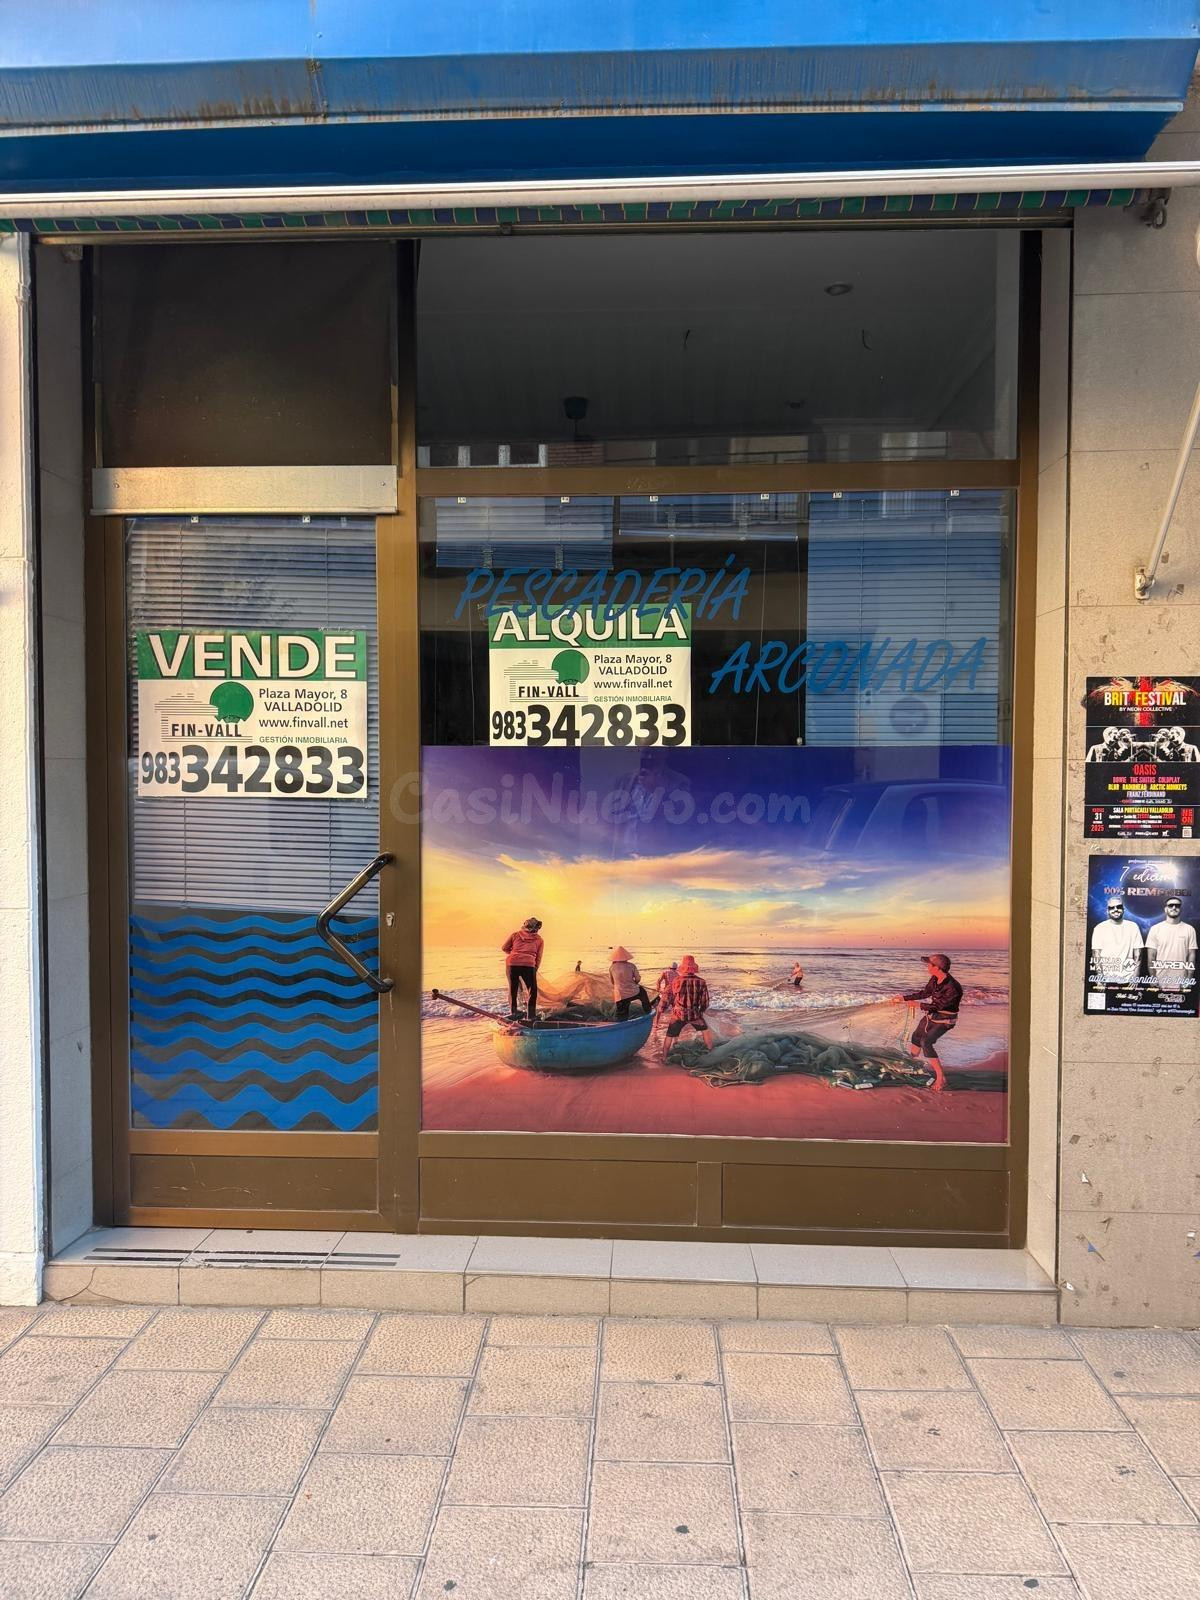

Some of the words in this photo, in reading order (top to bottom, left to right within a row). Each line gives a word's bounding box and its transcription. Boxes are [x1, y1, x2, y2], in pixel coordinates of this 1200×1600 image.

[454, 553, 752, 620] PESCADERÍA
[491, 608, 689, 647] ALQUILA
[149, 634, 357, 679] VENDE
[594, 655, 622, 664] Plaza
[625, 655, 664, 667] Mayor,
[665, 655, 673, 664] 8
[598, 666, 668, 675] VALLADOLID
[708, 636, 987, 694] ARCONADA
[593, 680, 673, 689] www.finvall.net
[259, 688, 291, 700] Plaza
[294, 688, 337, 703] Mayor,
[340, 688, 348, 699] 8
[518, 686, 580, 698] FIN-VALL
[1104, 691, 1130, 706] BRIT
[1135, 691, 1187, 706] FESTIVAL
[264, 702, 342, 713] VALLADOLID
[259, 716, 349, 730] www.finvall.net
[171, 723, 242, 738] FIN-VALL
[259, 735, 293, 744] GESTIÓN
[295, 736, 348, 744] INMOBILIARIA
[1133, 764, 1157, 776] OASIS
